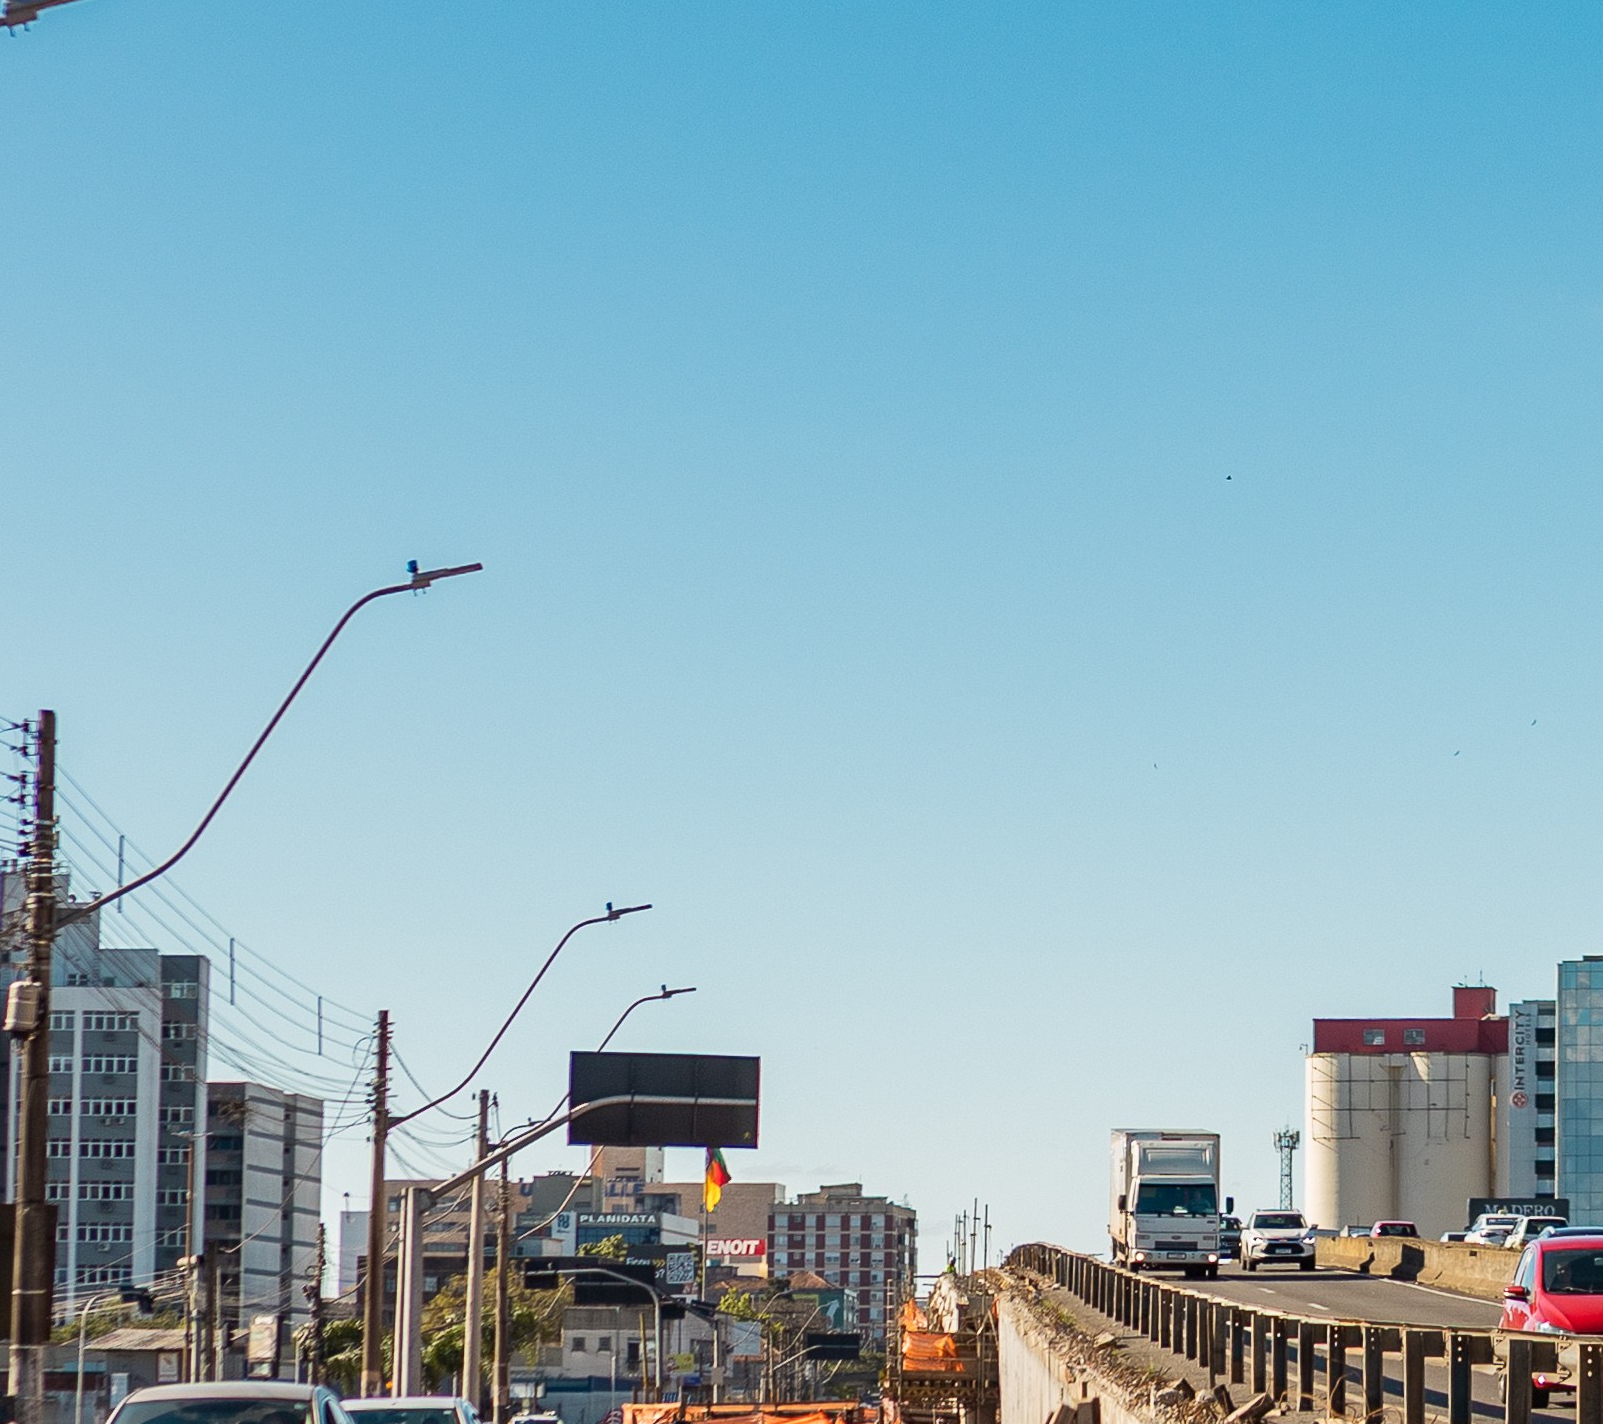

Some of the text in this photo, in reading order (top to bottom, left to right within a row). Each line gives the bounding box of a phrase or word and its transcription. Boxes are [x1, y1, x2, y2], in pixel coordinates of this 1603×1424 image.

[1514, 1009, 1525, 1090] INTERCITY
[579, 1214, 656, 1223] PLANIDATA
[700, 1239, 759, 1256] ENOIT
